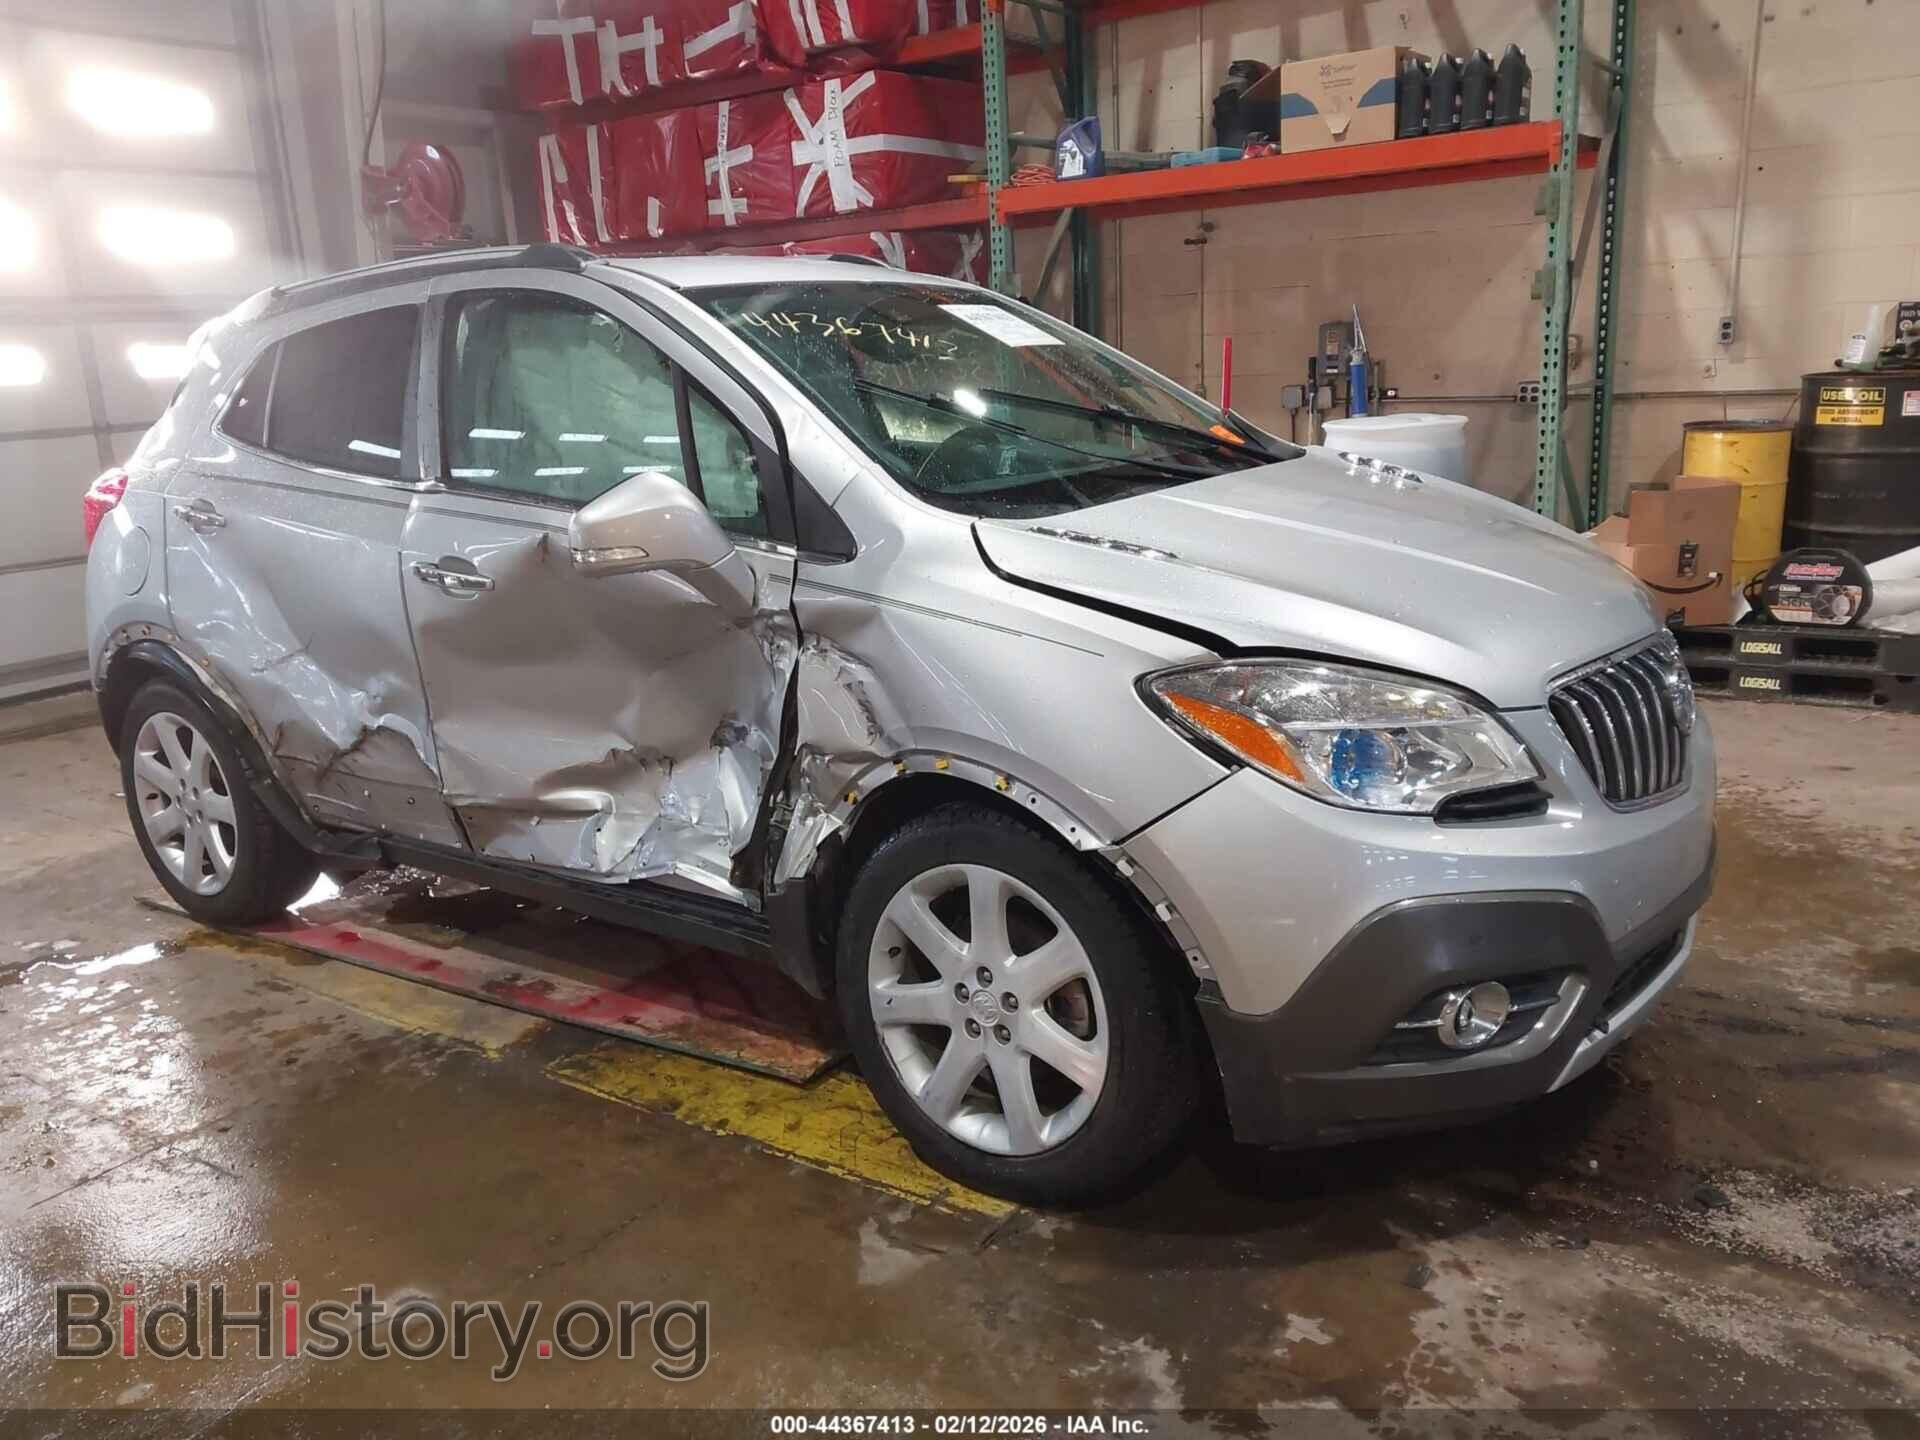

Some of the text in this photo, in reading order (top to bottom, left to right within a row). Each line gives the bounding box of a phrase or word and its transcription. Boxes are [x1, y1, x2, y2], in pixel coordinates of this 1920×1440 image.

[830, 129, 845, 167] FOAM
[1823, 390, 1883, 401] USE OIL
